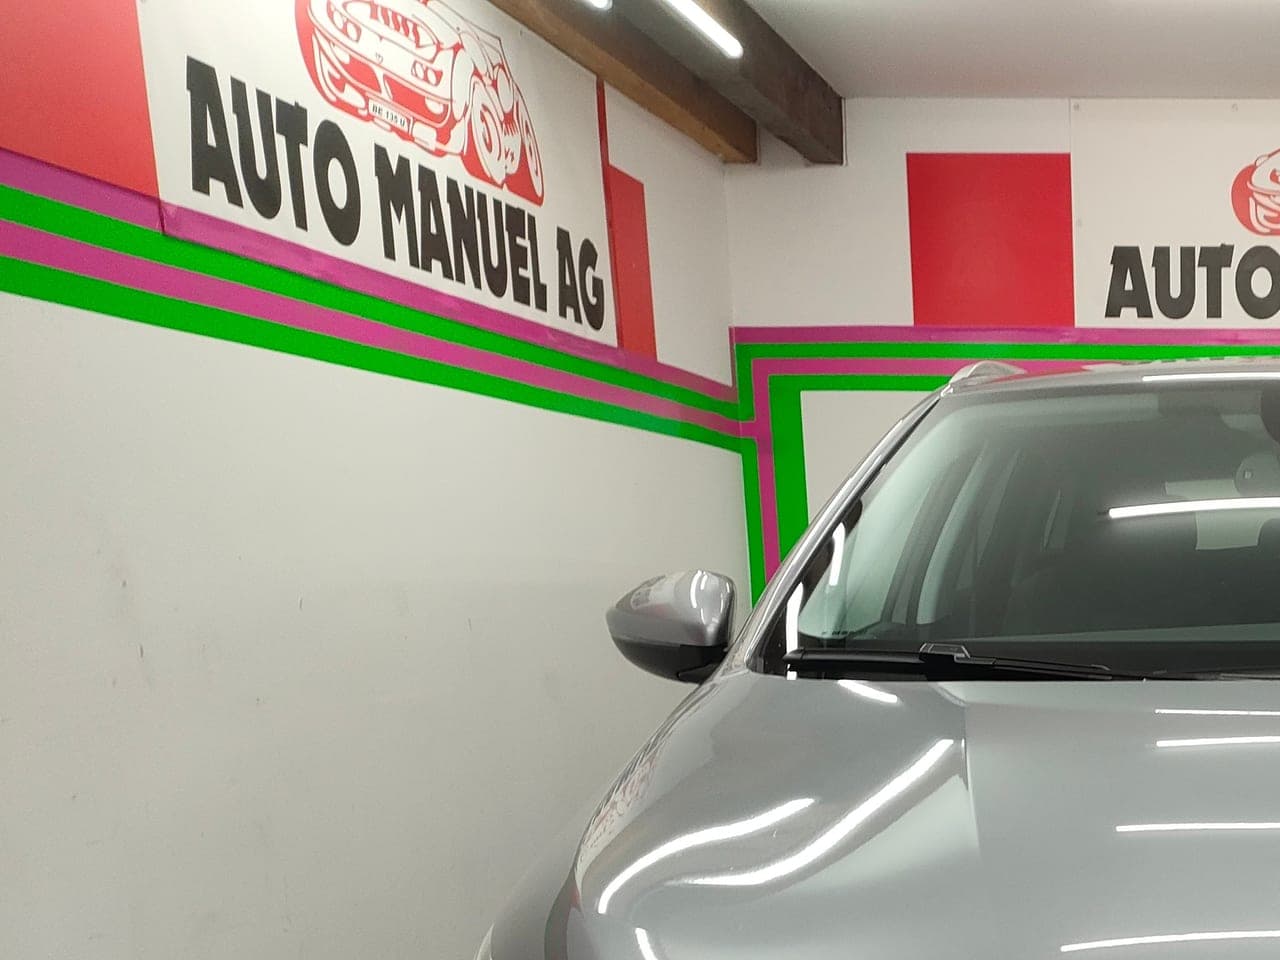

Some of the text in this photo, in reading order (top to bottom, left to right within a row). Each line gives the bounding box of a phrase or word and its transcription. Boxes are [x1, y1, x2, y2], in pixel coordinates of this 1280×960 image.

[186, 55, 605, 332] AUTO MANUEL AG
